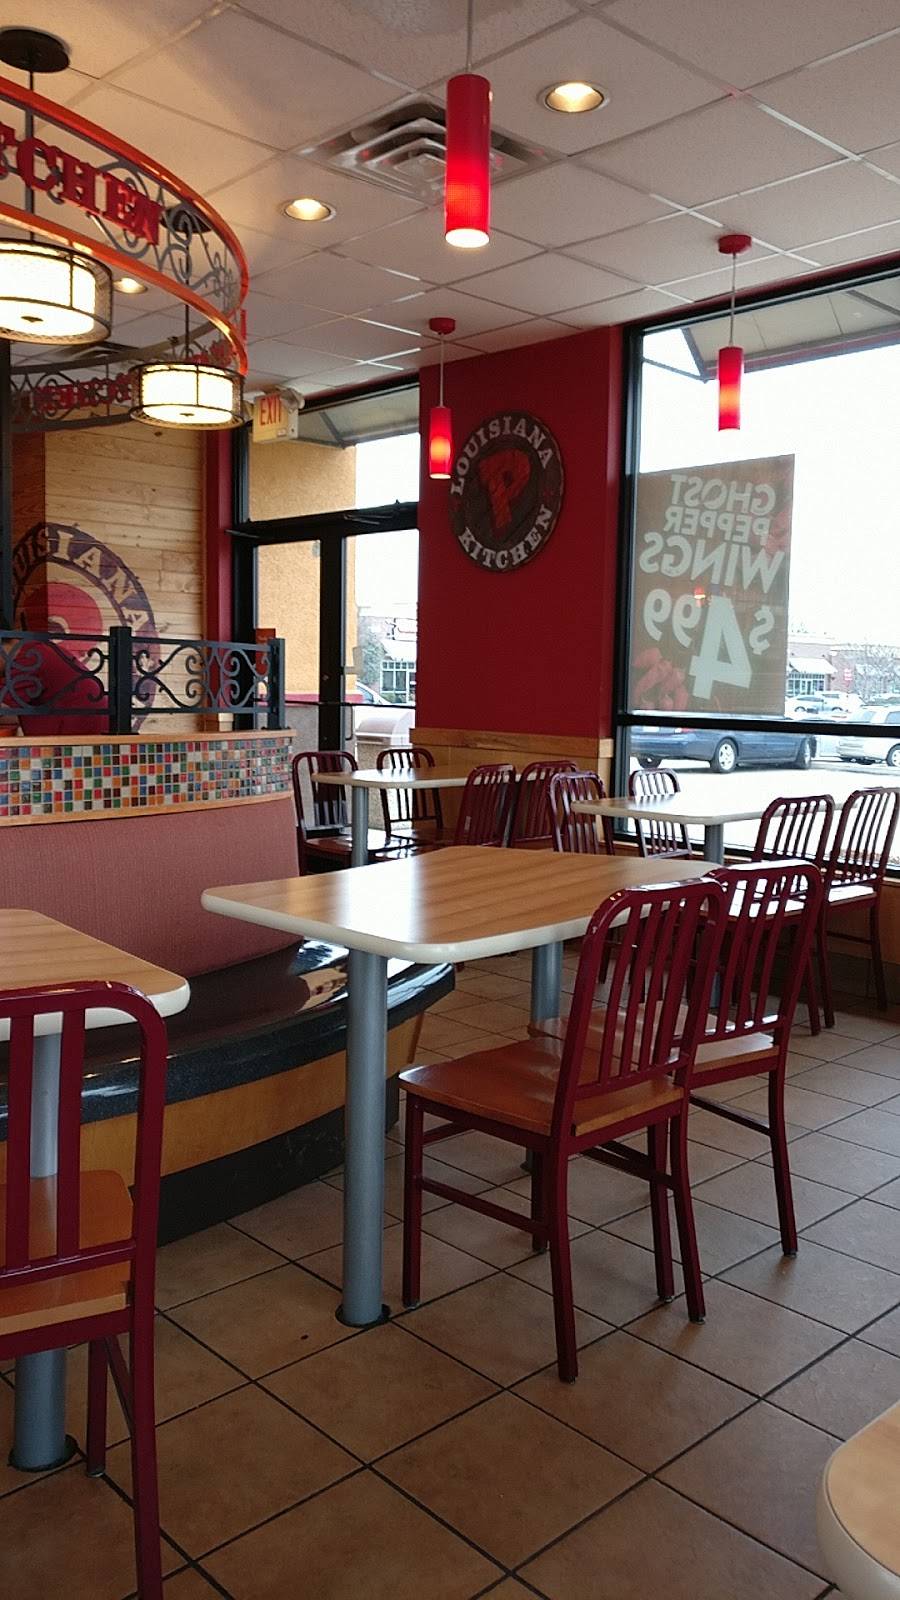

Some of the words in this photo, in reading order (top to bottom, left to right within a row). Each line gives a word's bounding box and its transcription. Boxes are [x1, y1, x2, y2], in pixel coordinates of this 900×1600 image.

[259, 394, 283, 427] EXIT
[450, 416, 554, 496] LOUISIANA
[458, 503, 553, 569] KITCHEN
